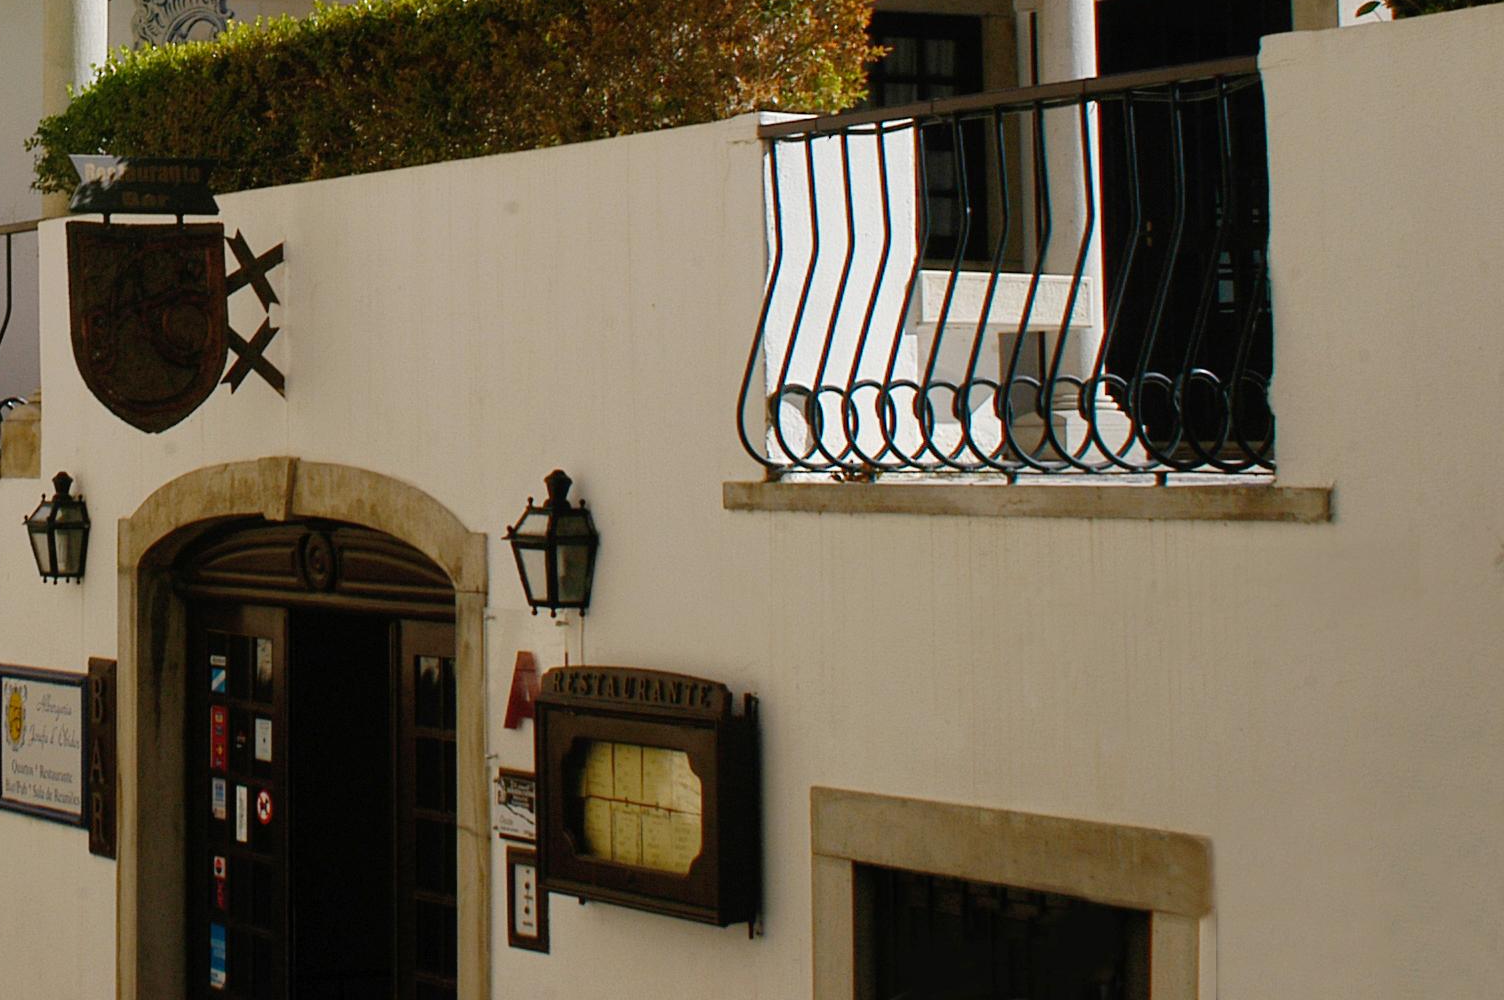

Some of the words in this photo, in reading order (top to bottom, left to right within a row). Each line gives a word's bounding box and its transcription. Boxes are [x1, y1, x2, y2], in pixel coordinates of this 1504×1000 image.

[83, 161, 201, 185] Restaurante
[552, 670, 713, 709] RESTAURANTE
[89, 675, 105, 844] BAR
